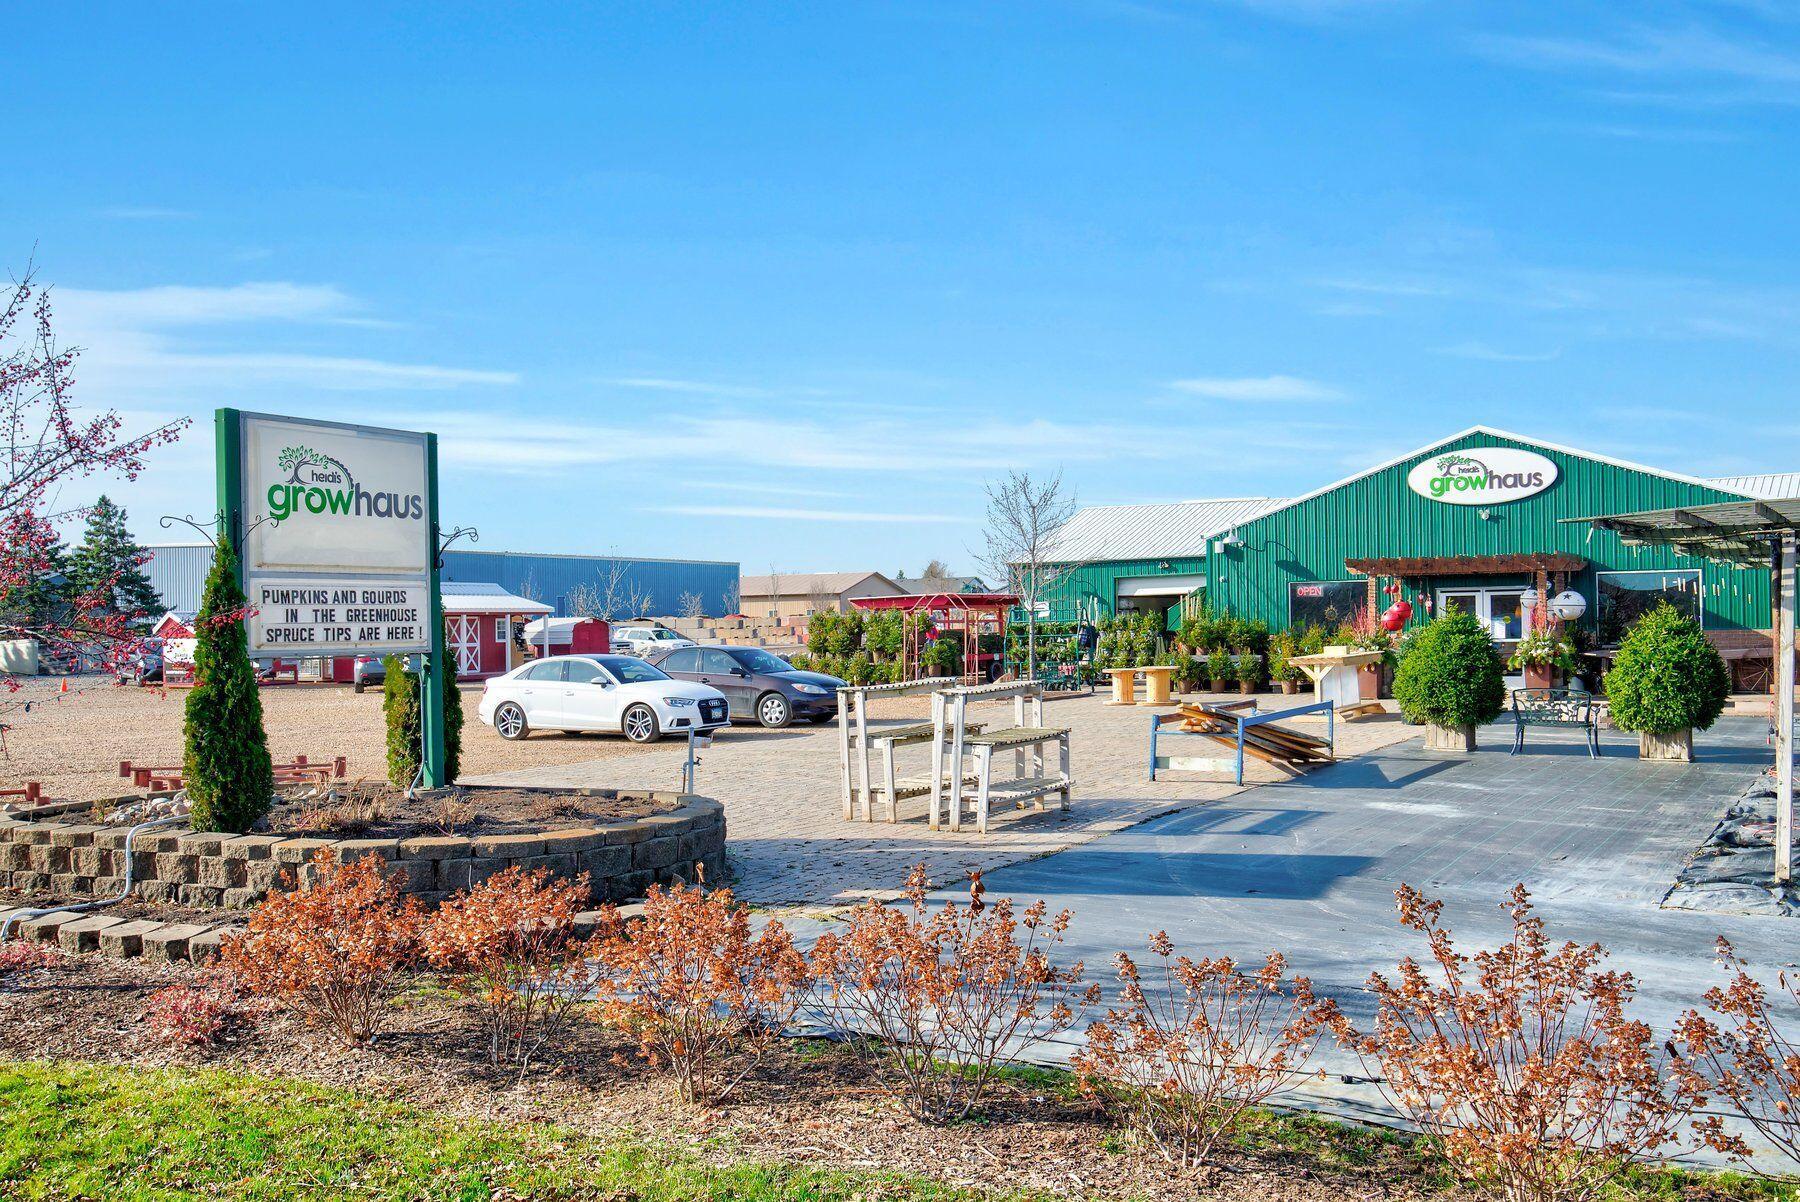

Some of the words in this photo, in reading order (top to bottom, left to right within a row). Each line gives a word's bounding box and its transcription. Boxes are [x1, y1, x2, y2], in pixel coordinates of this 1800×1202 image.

[1429, 470, 1543, 497] growhaus
[267, 482, 423, 521] growhaus
[262, 589, 328, 604] PUMPKINS
[332, 591, 357, 604] AND
[362, 590, 407, 604] GOURDS
[1297, 586, 1322, 596] OPEN
[285, 608, 298, 623] IN
[312, 609, 336, 623] THE
[346, 608, 417, 623] GREENHOUSE
[266, 628, 315, 642] SPRUCE
[323, 627, 352, 641] TIPS
[358, 627, 380, 640] ARE
[387, 626, 414, 640] HERE
